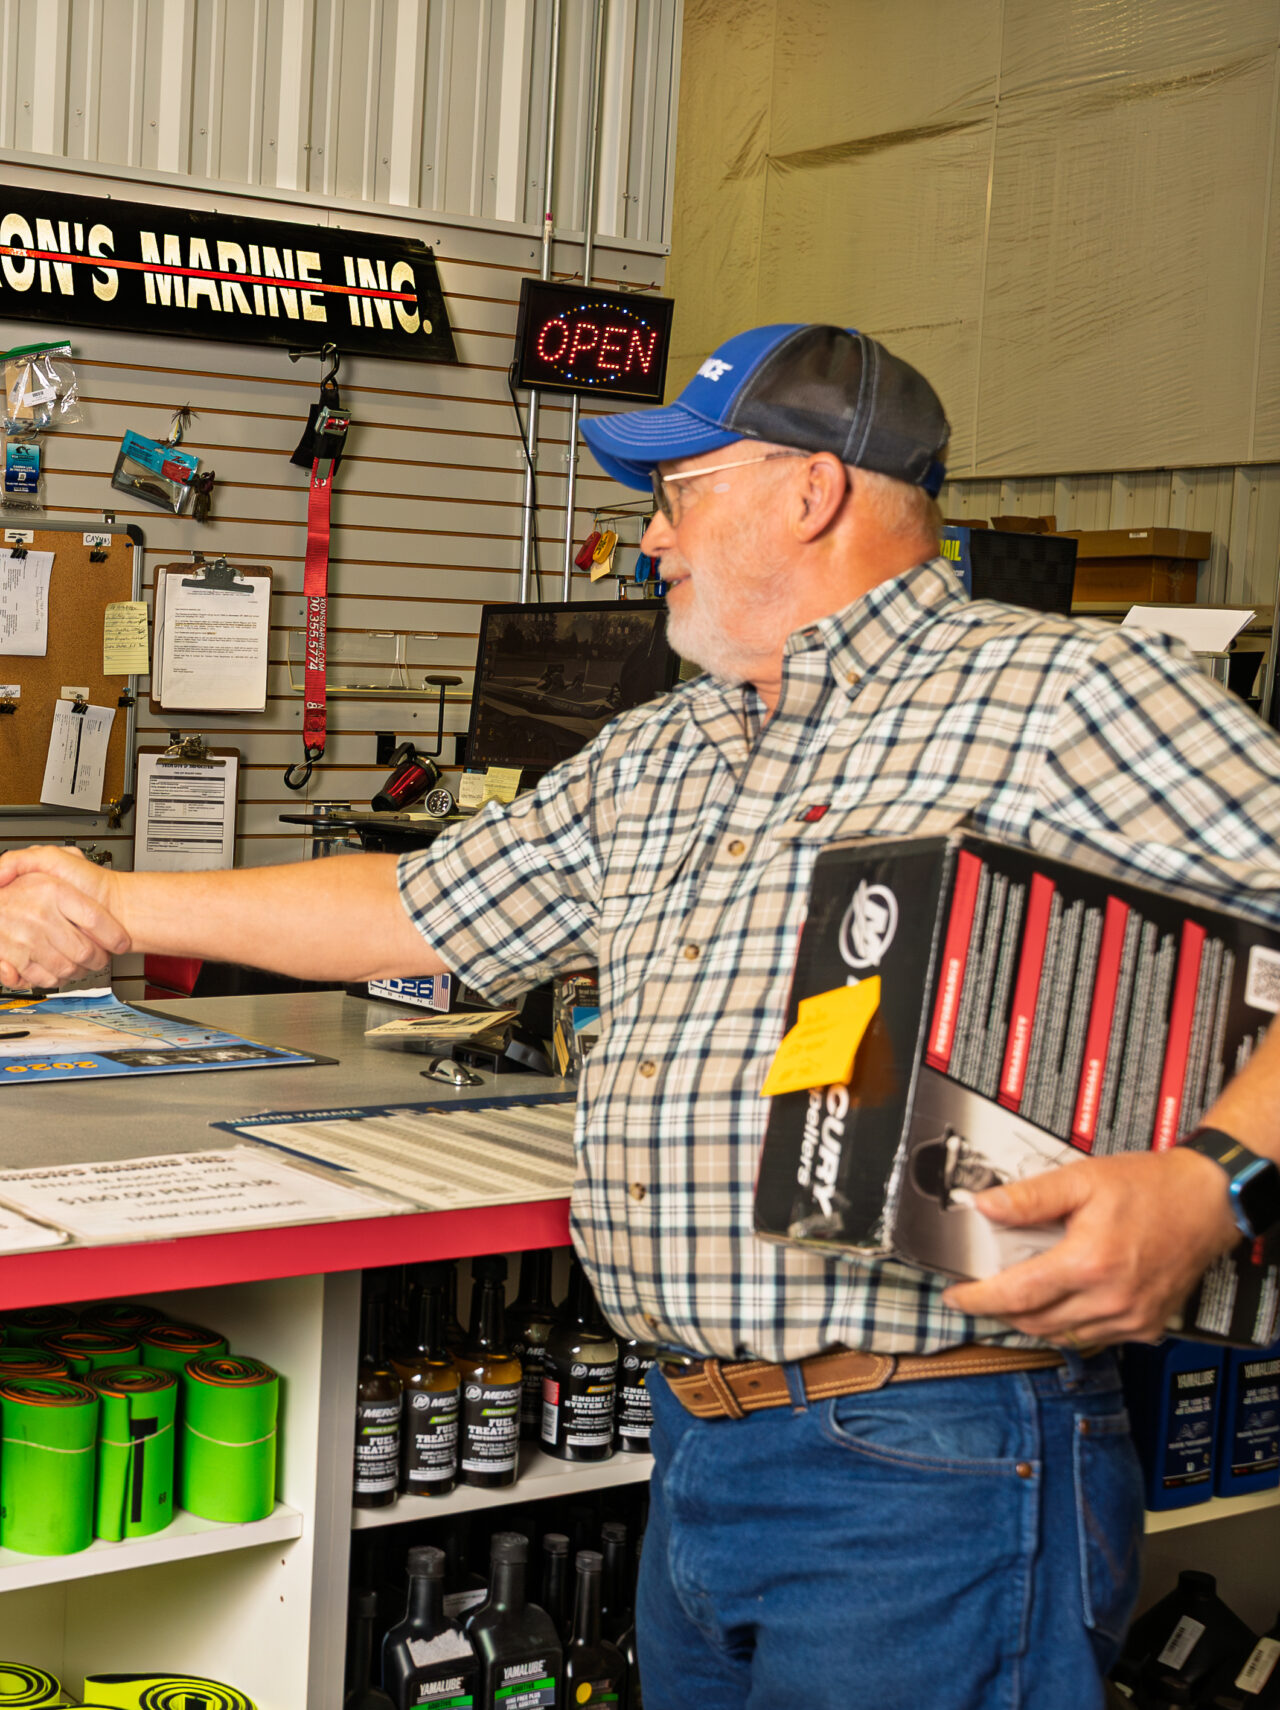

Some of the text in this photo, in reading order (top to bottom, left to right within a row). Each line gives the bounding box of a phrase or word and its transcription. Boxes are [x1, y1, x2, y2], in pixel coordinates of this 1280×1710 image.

[140, 231, 327, 323] MARINE
[343, 256, 432, 334] INC.
[537, 319, 656, 374] OPEN
[308, 596, 320, 671] 00.355.5774
[318, 597, 328, 672] XONSMARINE.COM
[295, 1108, 364, 1119] YAMAHA
[813, 1085, 850, 1219] CURY
[1177, 1369, 1216, 1389] YAMALUBE
[564, 1400, 602, 1409] SYSTEM
[488, 1418, 513, 1427] FUEL
[369, 1436, 394, 1446] FUEL
[504, 1661, 545, 1680] YAMALUBE
[420, 1678, 463, 1697] YAMALUBE
